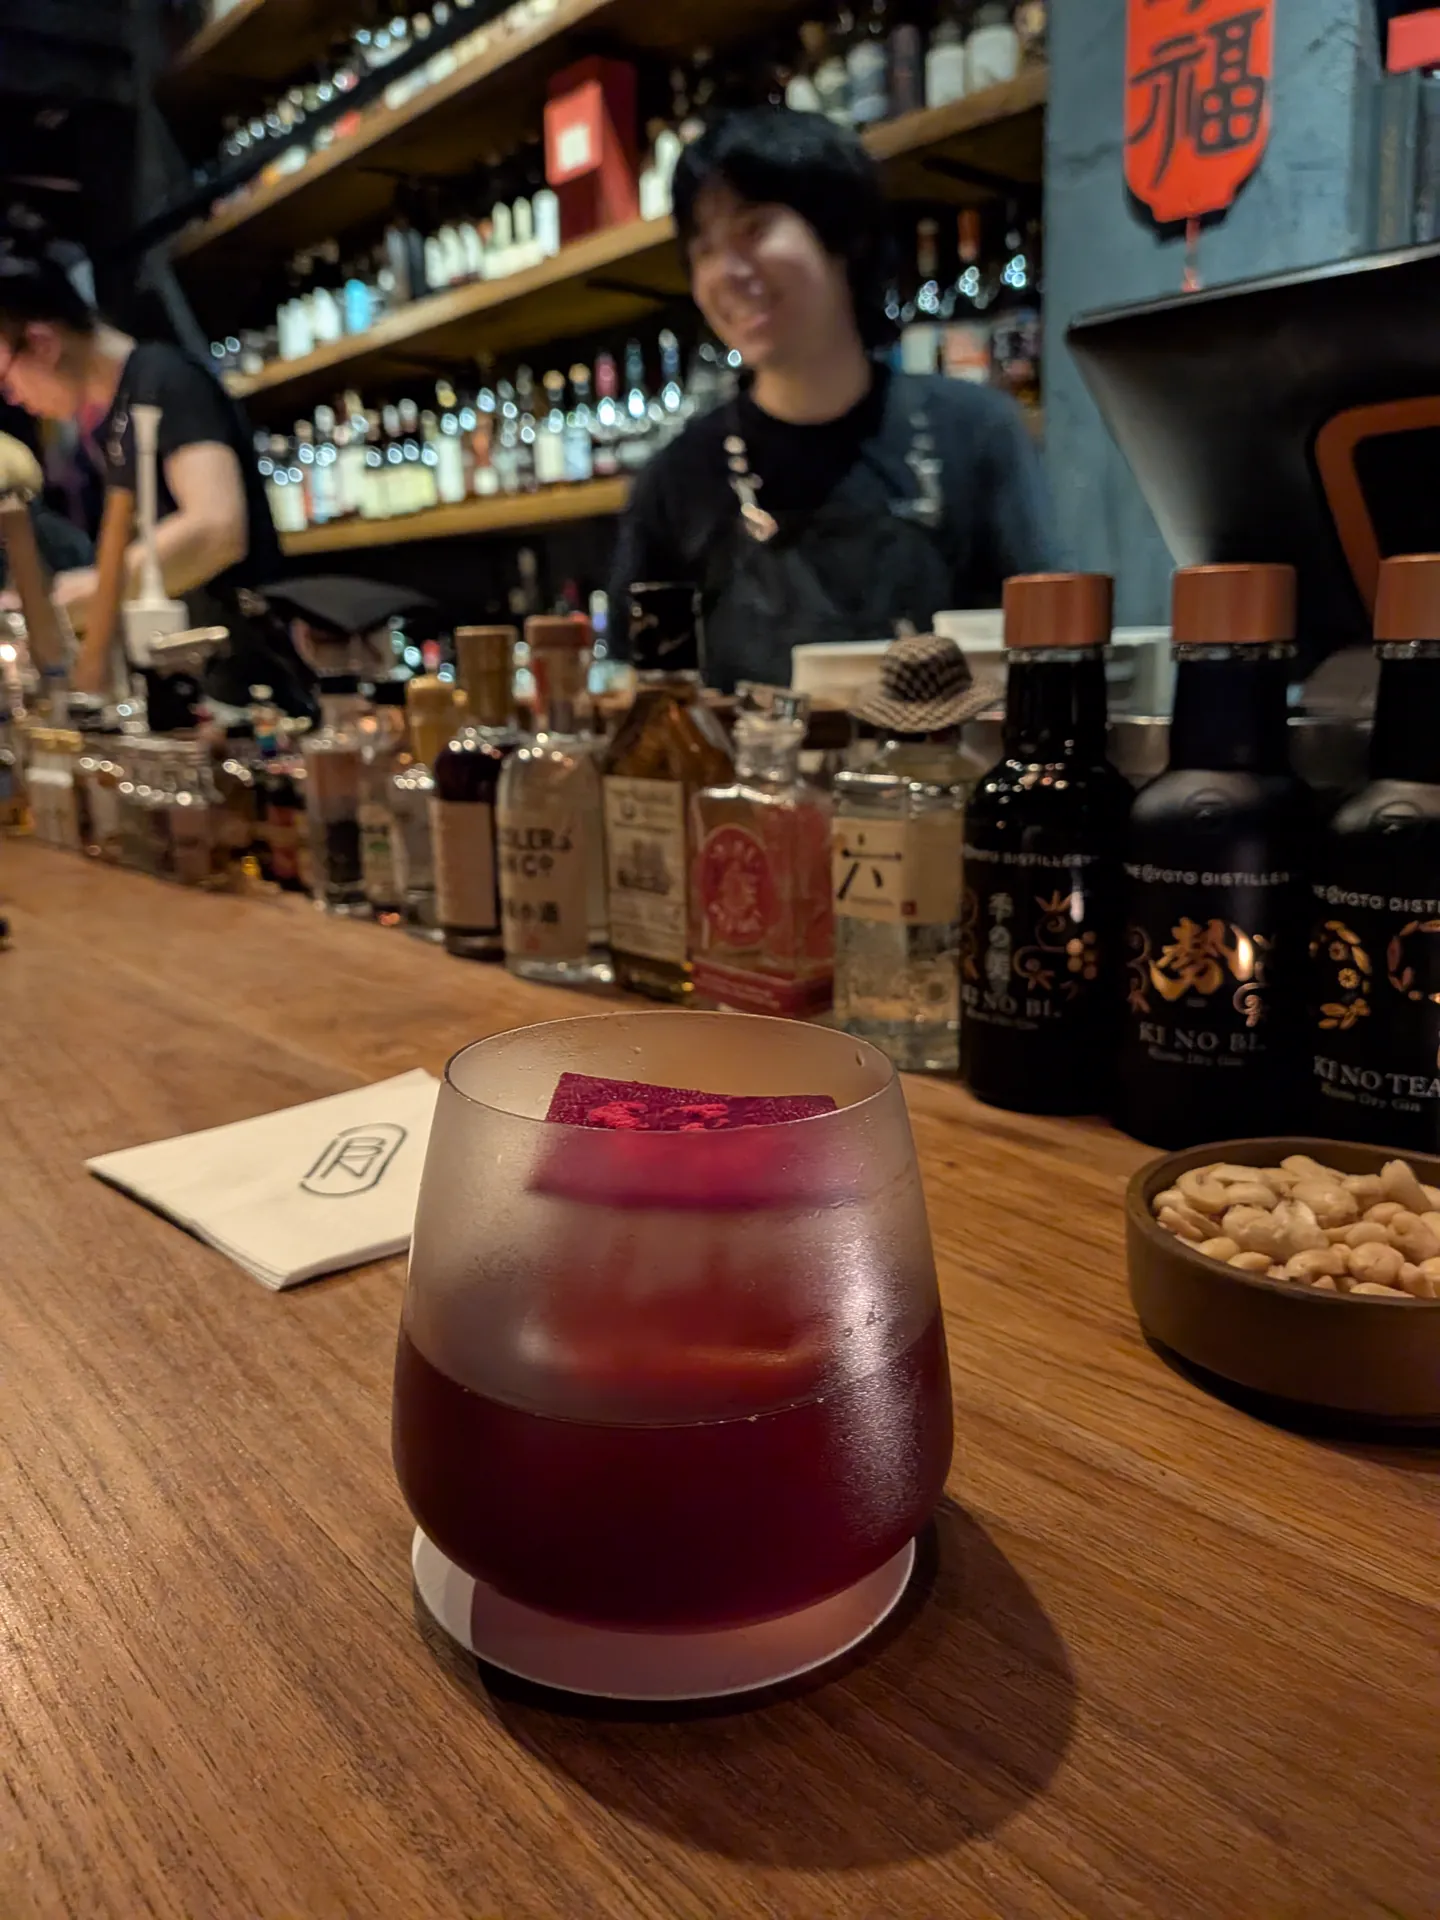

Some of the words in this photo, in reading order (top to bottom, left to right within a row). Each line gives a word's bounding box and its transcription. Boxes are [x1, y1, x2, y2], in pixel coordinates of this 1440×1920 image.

[1127, 0, 1265, 189] 福
[836, 833, 903, 901] 六
[1139, 1021, 1166, 1046] KI
[1174, 1027, 1219, 1052] NO
[1312, 1055, 1339, 1082] KI
[1339, 1063, 1384, 1091] NO
[1384, 1073, 1440, 1099] TEA
